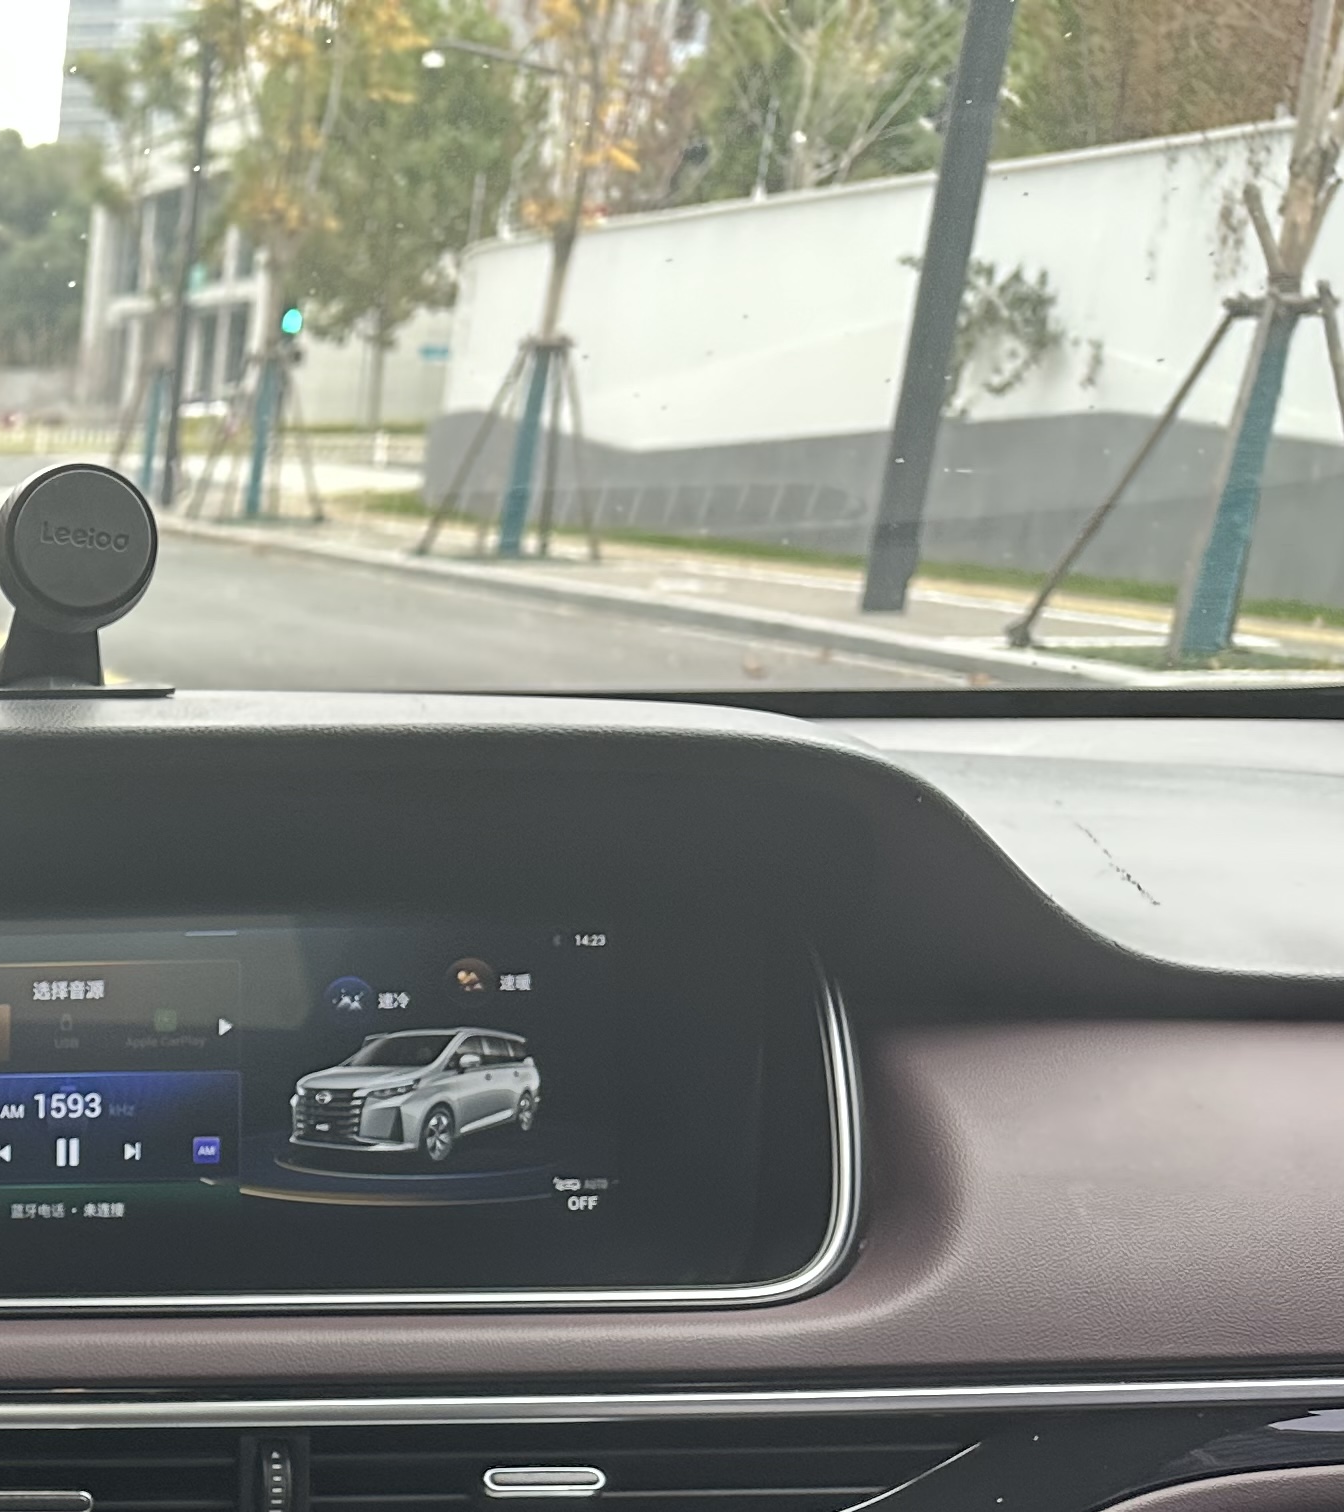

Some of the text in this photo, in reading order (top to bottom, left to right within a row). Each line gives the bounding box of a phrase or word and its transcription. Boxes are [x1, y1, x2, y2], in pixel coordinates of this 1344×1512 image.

[574, 934, 606, 947] 14:23
[32, 980, 106, 1001] 选择音源
[378, 992, 411, 1010] 速冷
[0, 1103, 26, 1119] AM
[33, 1092, 102, 1119] 1593
[197, 1144, 217, 1157] AM
[567, 1195, 599, 1211] OFF
